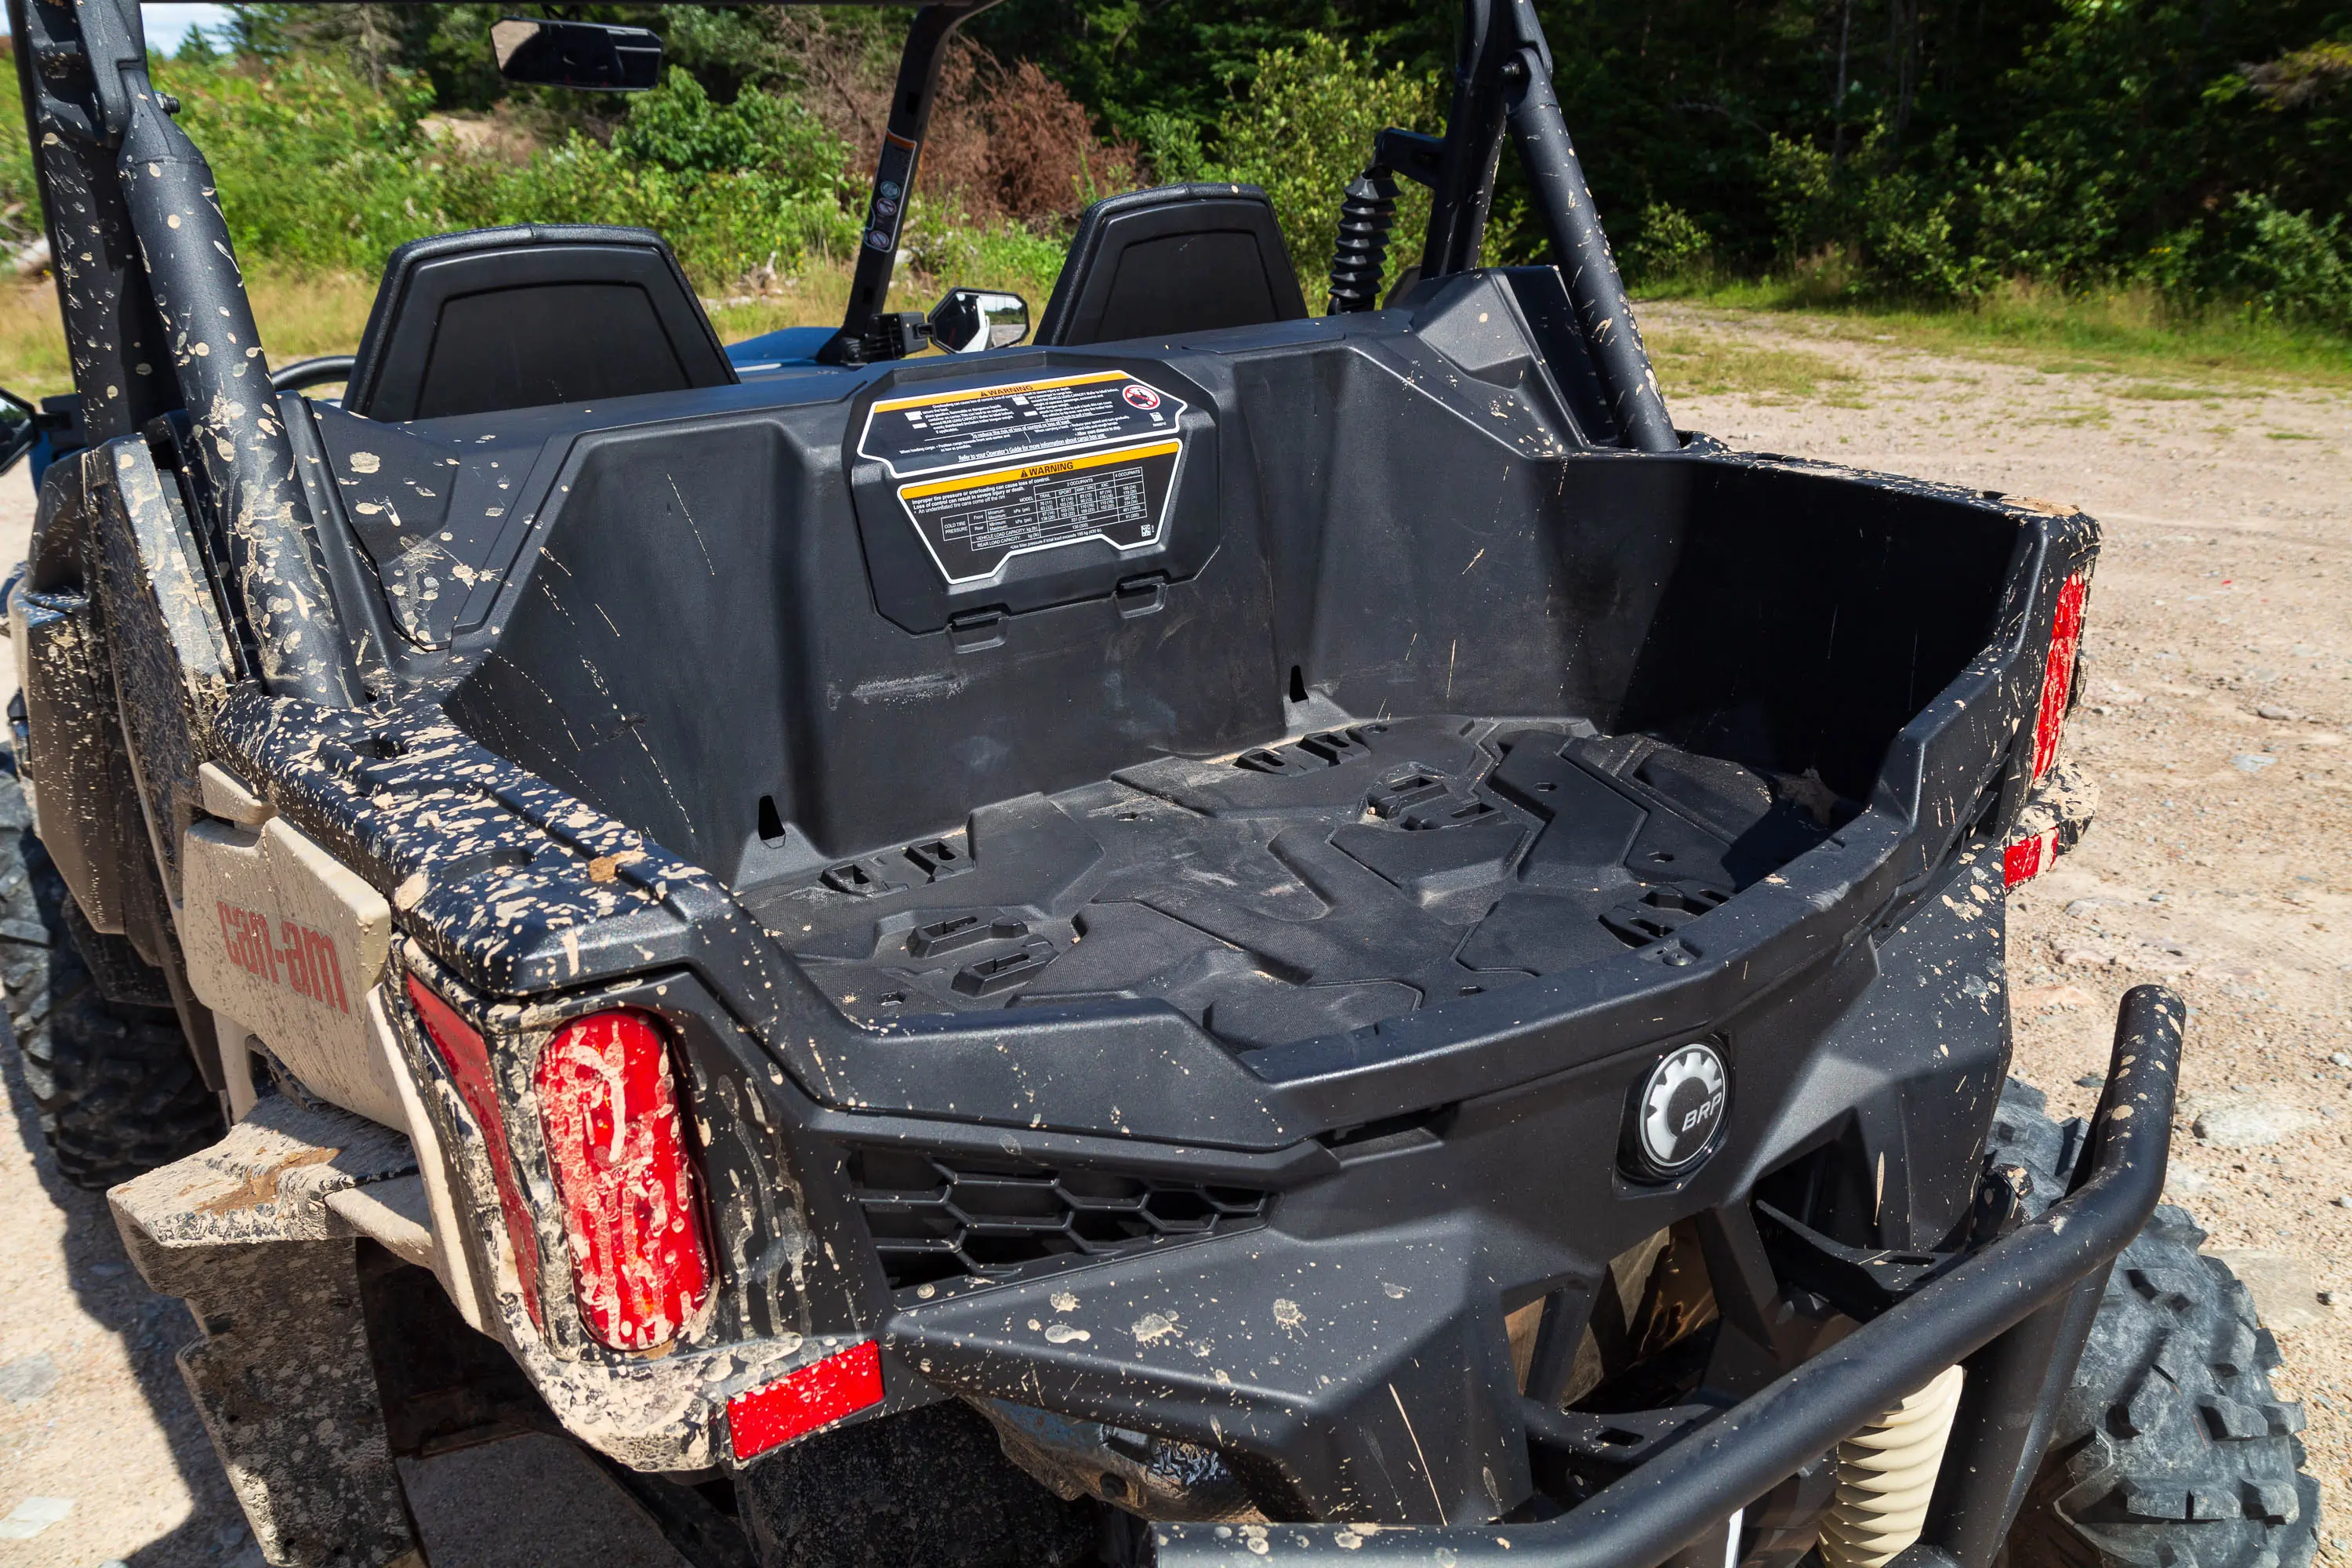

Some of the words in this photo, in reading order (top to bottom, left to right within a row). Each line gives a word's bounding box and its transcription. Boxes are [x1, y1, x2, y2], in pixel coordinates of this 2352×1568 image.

[989, 386, 1033, 396] WARNING
[1040, 439, 1065, 448] information
[1029, 461, 1073, 477] WARNING
[969, 486, 995, 495] overloading
[946, 526, 967, 535] PRESSURE
[216, 901, 350, 1014] can-am
[1682, 1092, 1722, 1132] BRP
